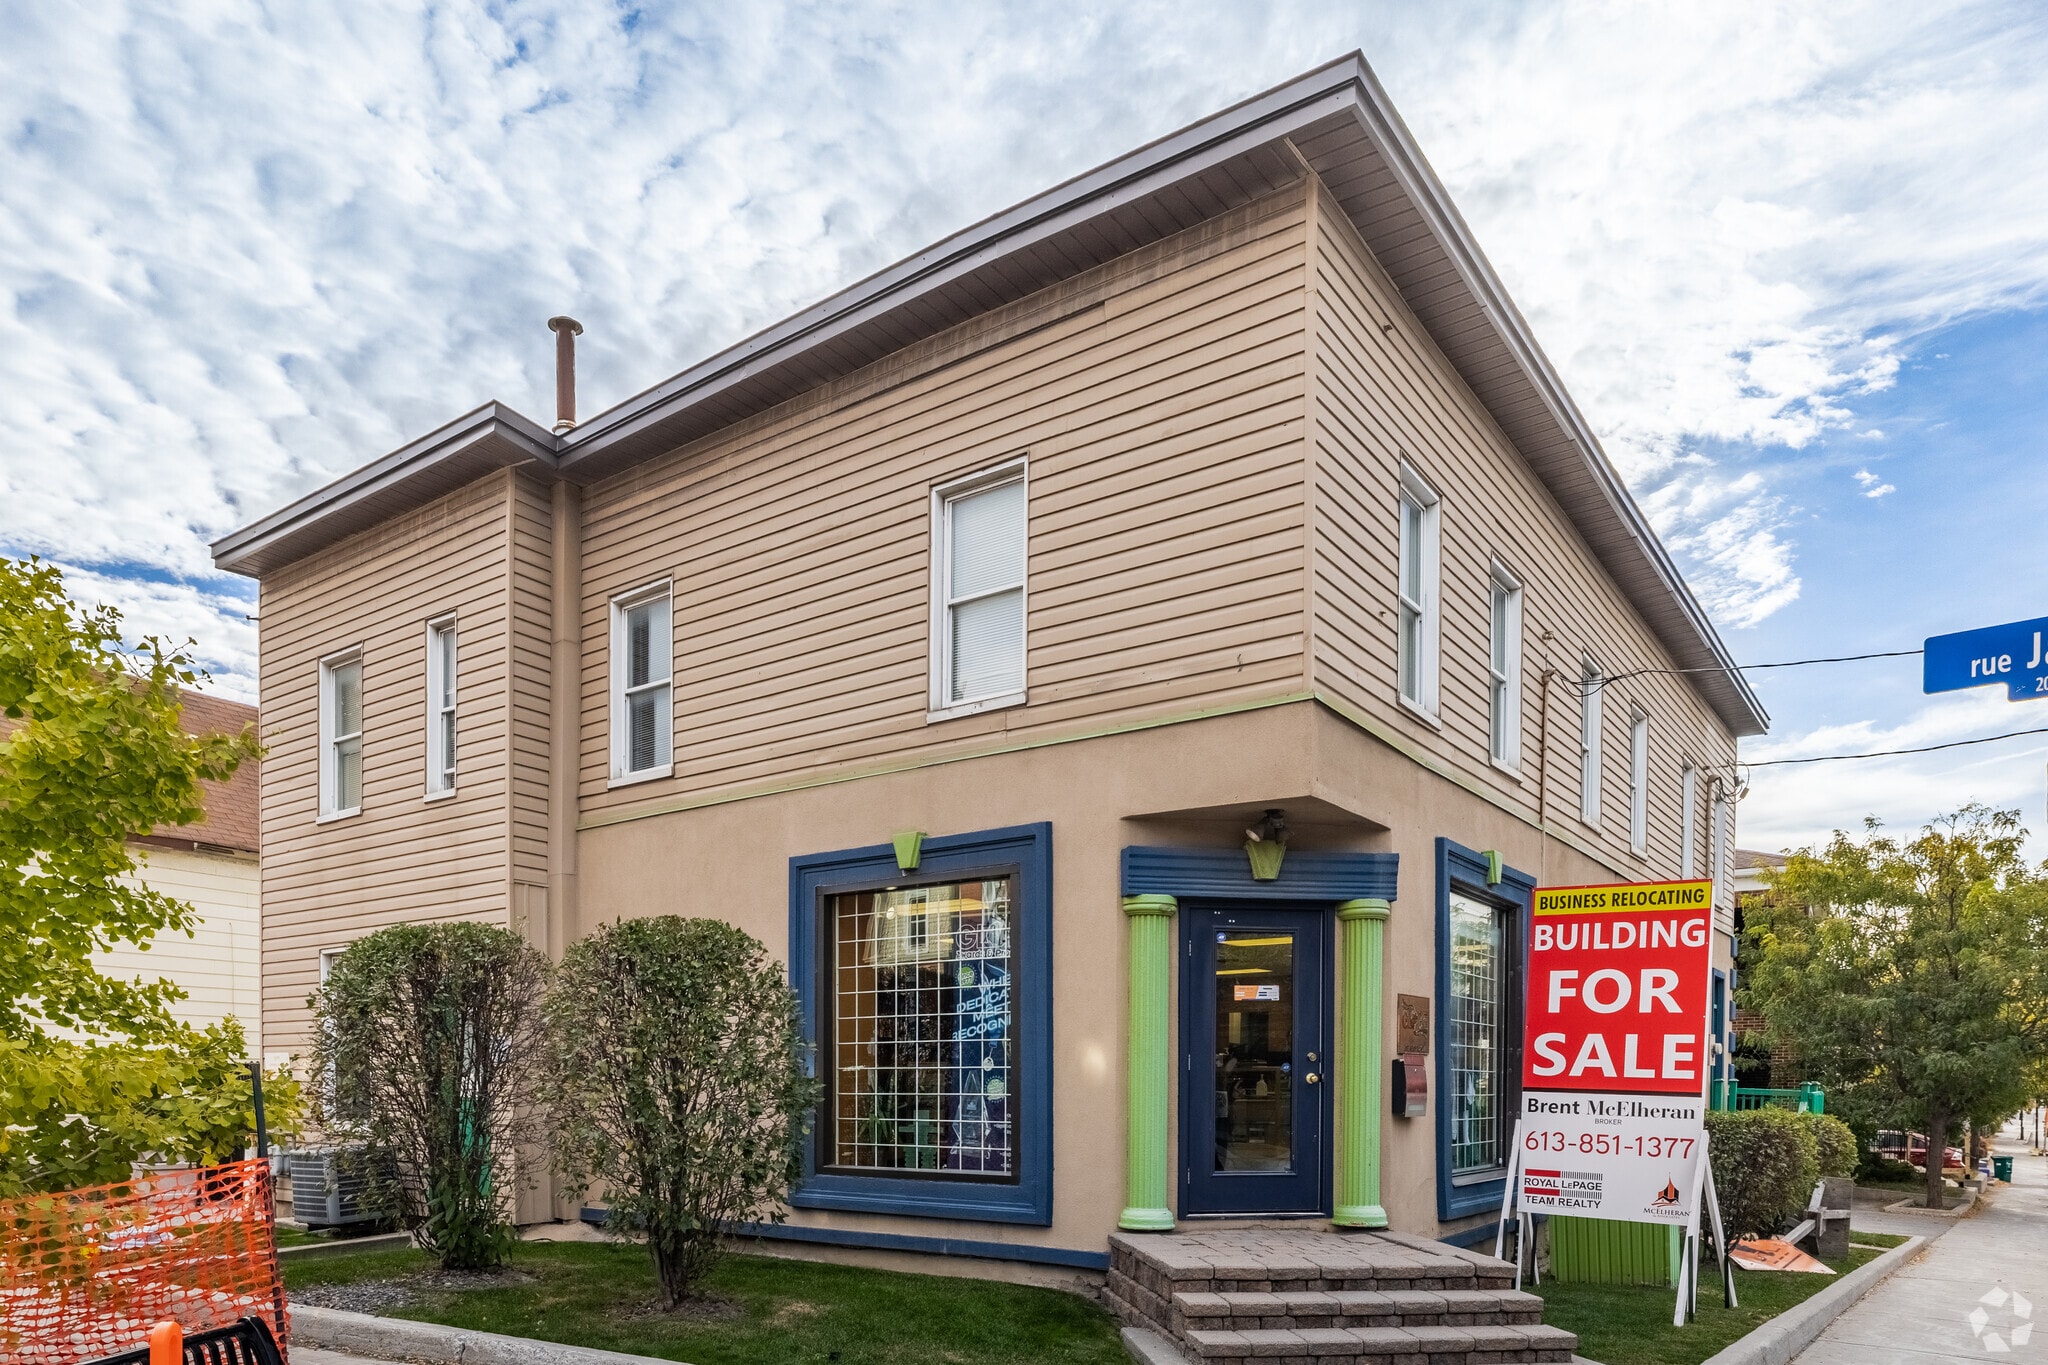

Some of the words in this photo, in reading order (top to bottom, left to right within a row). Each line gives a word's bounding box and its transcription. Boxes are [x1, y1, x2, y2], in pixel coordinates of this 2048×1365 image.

[1971, 654, 2012, 678] rue
[1540, 893, 1606, 910] BUSINESS
[1611, 888, 1705, 907] RELOCATING
[1534, 918, 1706, 951] BUILDING
[956, 987, 1011, 1014] DEDICA
[1548, 968, 1683, 1014] FOR
[1533, 1032, 1695, 1079] SALE
[1528, 1098, 1580, 1115] Brent
[1587, 1100, 1695, 1119] McElheran
[1525, 1130, 1695, 1159] 613-851-1377
[1524, 1177, 1559, 1188] ROYAL
[1525, 1195, 1554, 1206] TEAM
[1558, 1197, 1601, 1208] REALTY
